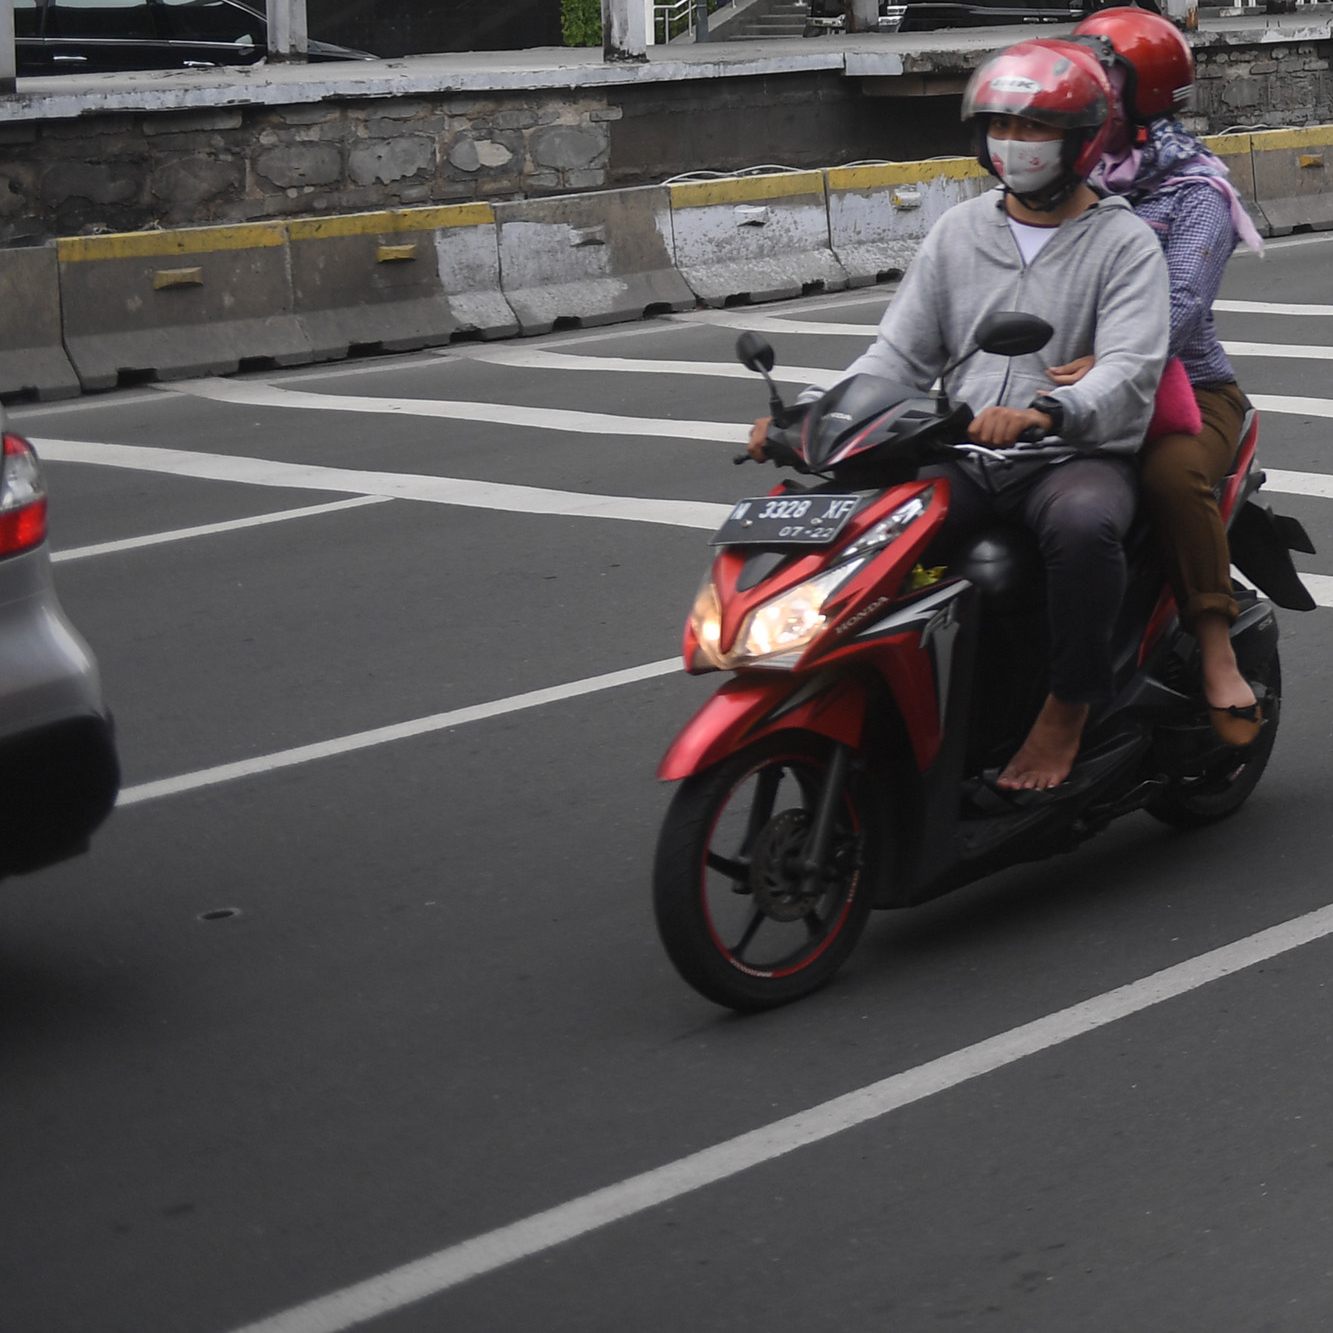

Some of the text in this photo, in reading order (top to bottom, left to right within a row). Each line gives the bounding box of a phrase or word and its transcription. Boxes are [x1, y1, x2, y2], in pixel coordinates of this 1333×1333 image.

[731, 500, 854, 520] N 3328 XF
[834, 596, 890, 634] HONDA
